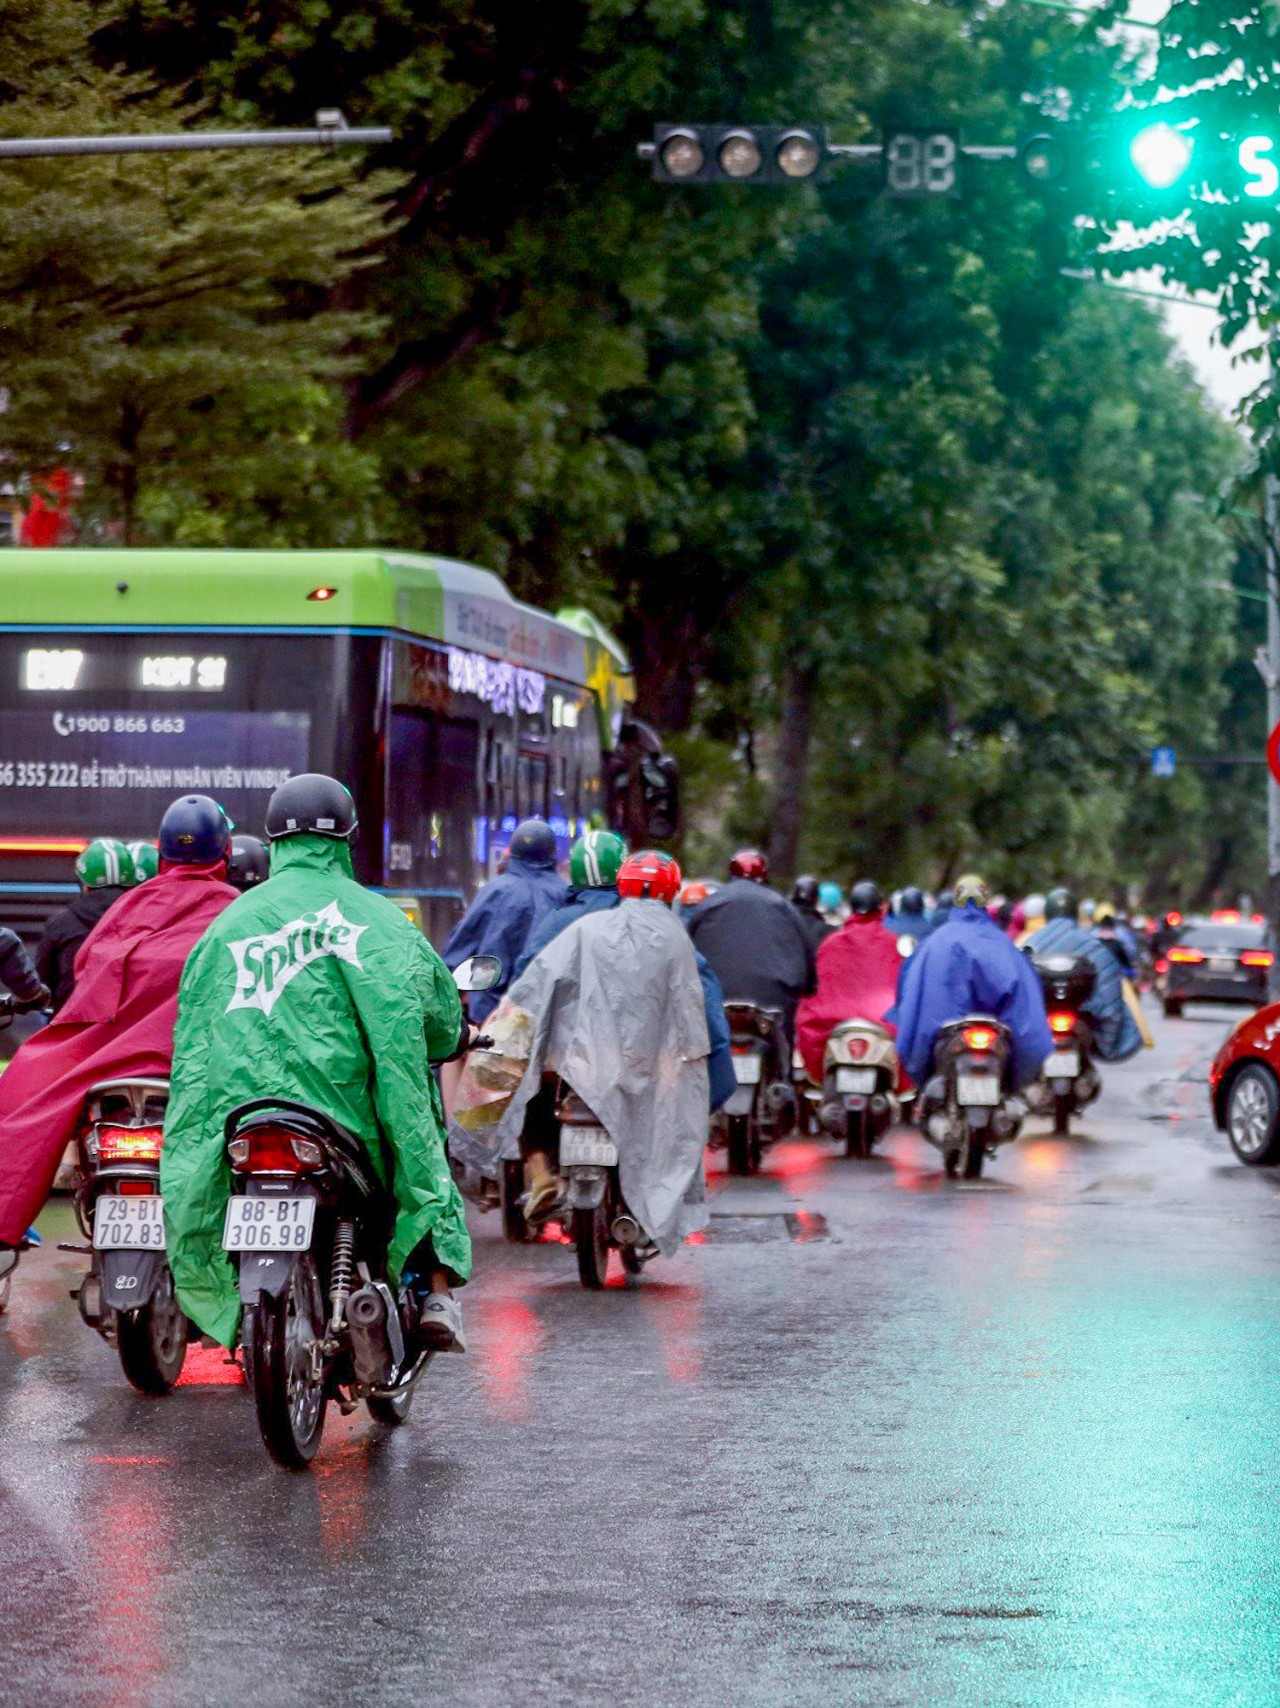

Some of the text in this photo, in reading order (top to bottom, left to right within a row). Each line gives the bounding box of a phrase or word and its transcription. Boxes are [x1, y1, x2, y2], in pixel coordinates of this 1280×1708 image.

[68, 717, 185, 734] 1900 866 663
[16, 762, 47, 788] 355
[48, 762, 79, 788] 222
[243, 911, 351, 1001] Sprite
[107, 1200, 158, 1221] 29-B1
[242, 1201, 300, 1222] 88-B1
[99, 1223, 163, 1245] 702.83
[230, 1224, 306, 1246] 306.98
